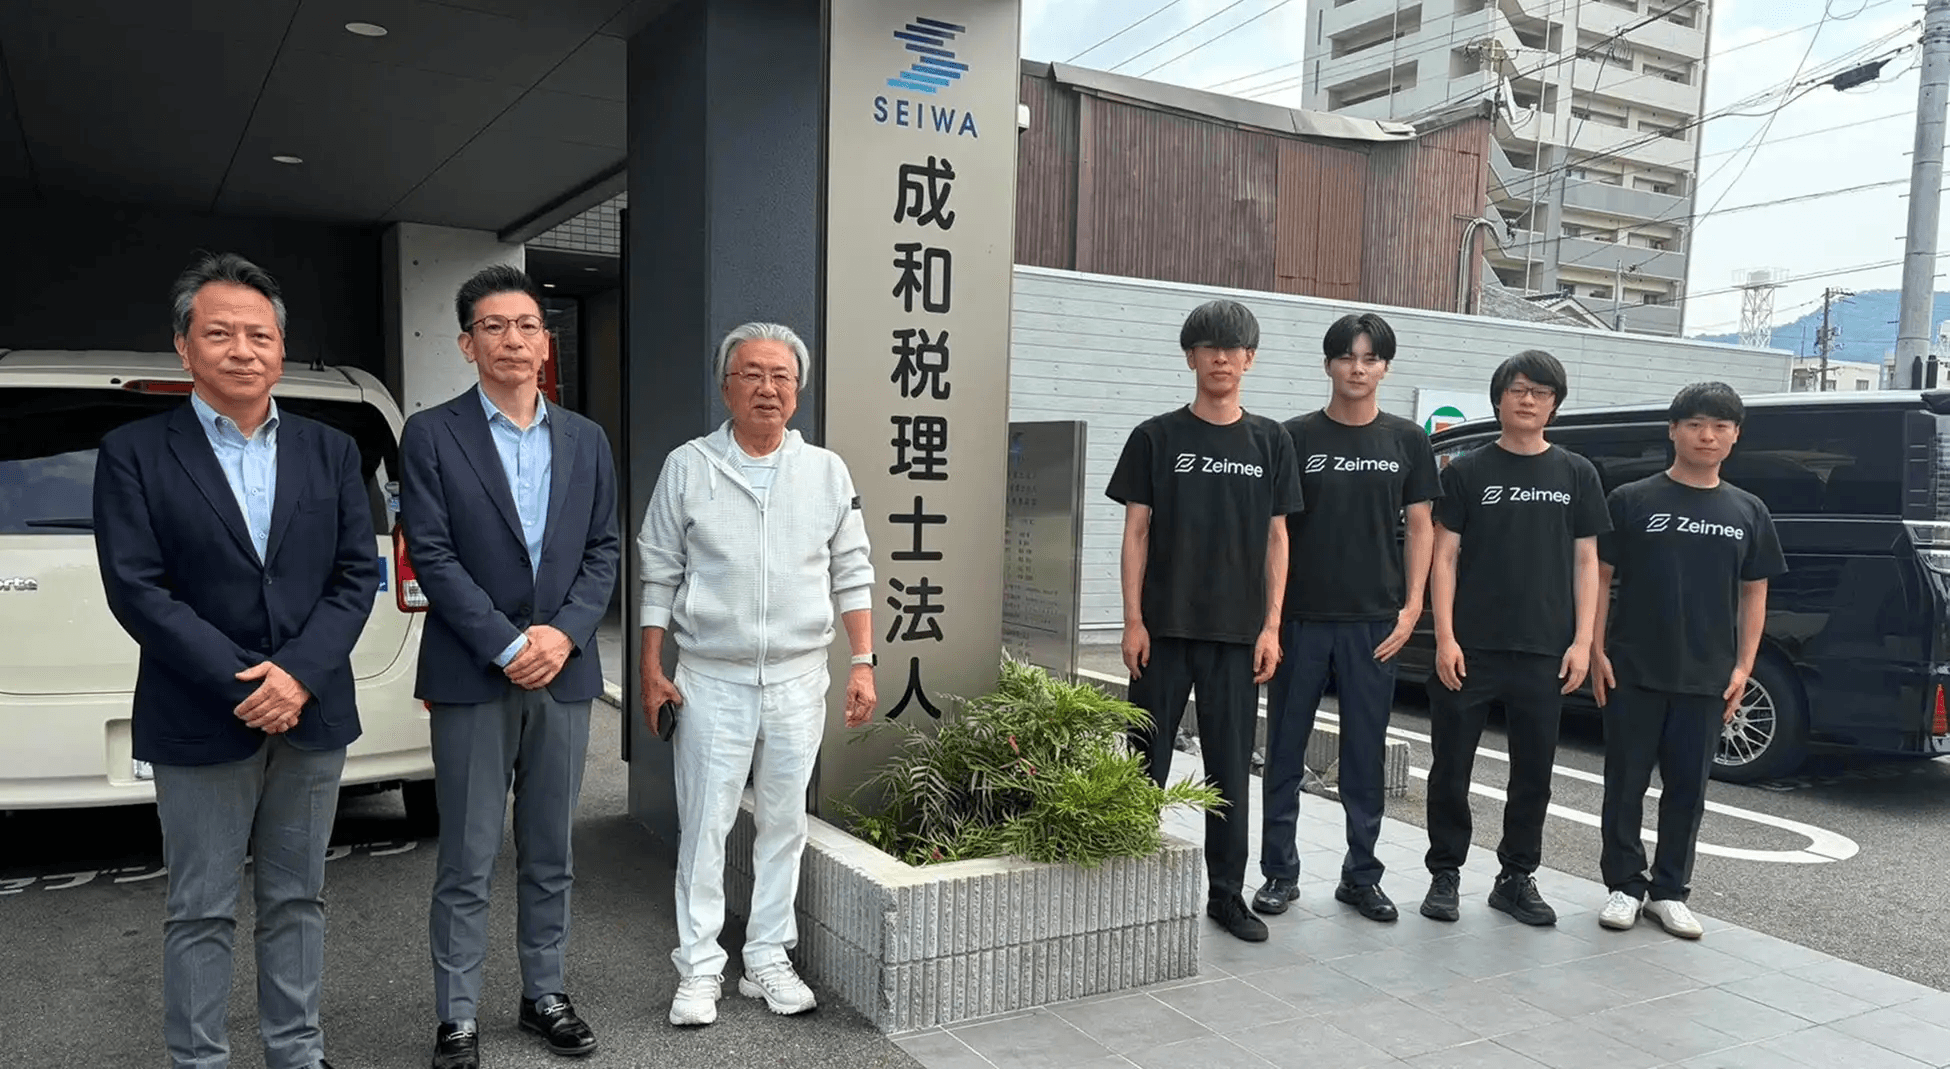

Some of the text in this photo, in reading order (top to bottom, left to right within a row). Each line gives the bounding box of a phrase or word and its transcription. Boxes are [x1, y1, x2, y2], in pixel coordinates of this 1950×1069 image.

[873, 95, 978, 139] SEIWA
[885, 155, 956, 721] 成和税理士法人
[1201, 456, 1263, 478] Zeimee
[1333, 456, 1400, 473] Zeimee
[1509, 486, 1571, 505] Zeimee
[1676, 516, 1744, 540] Zeimee
